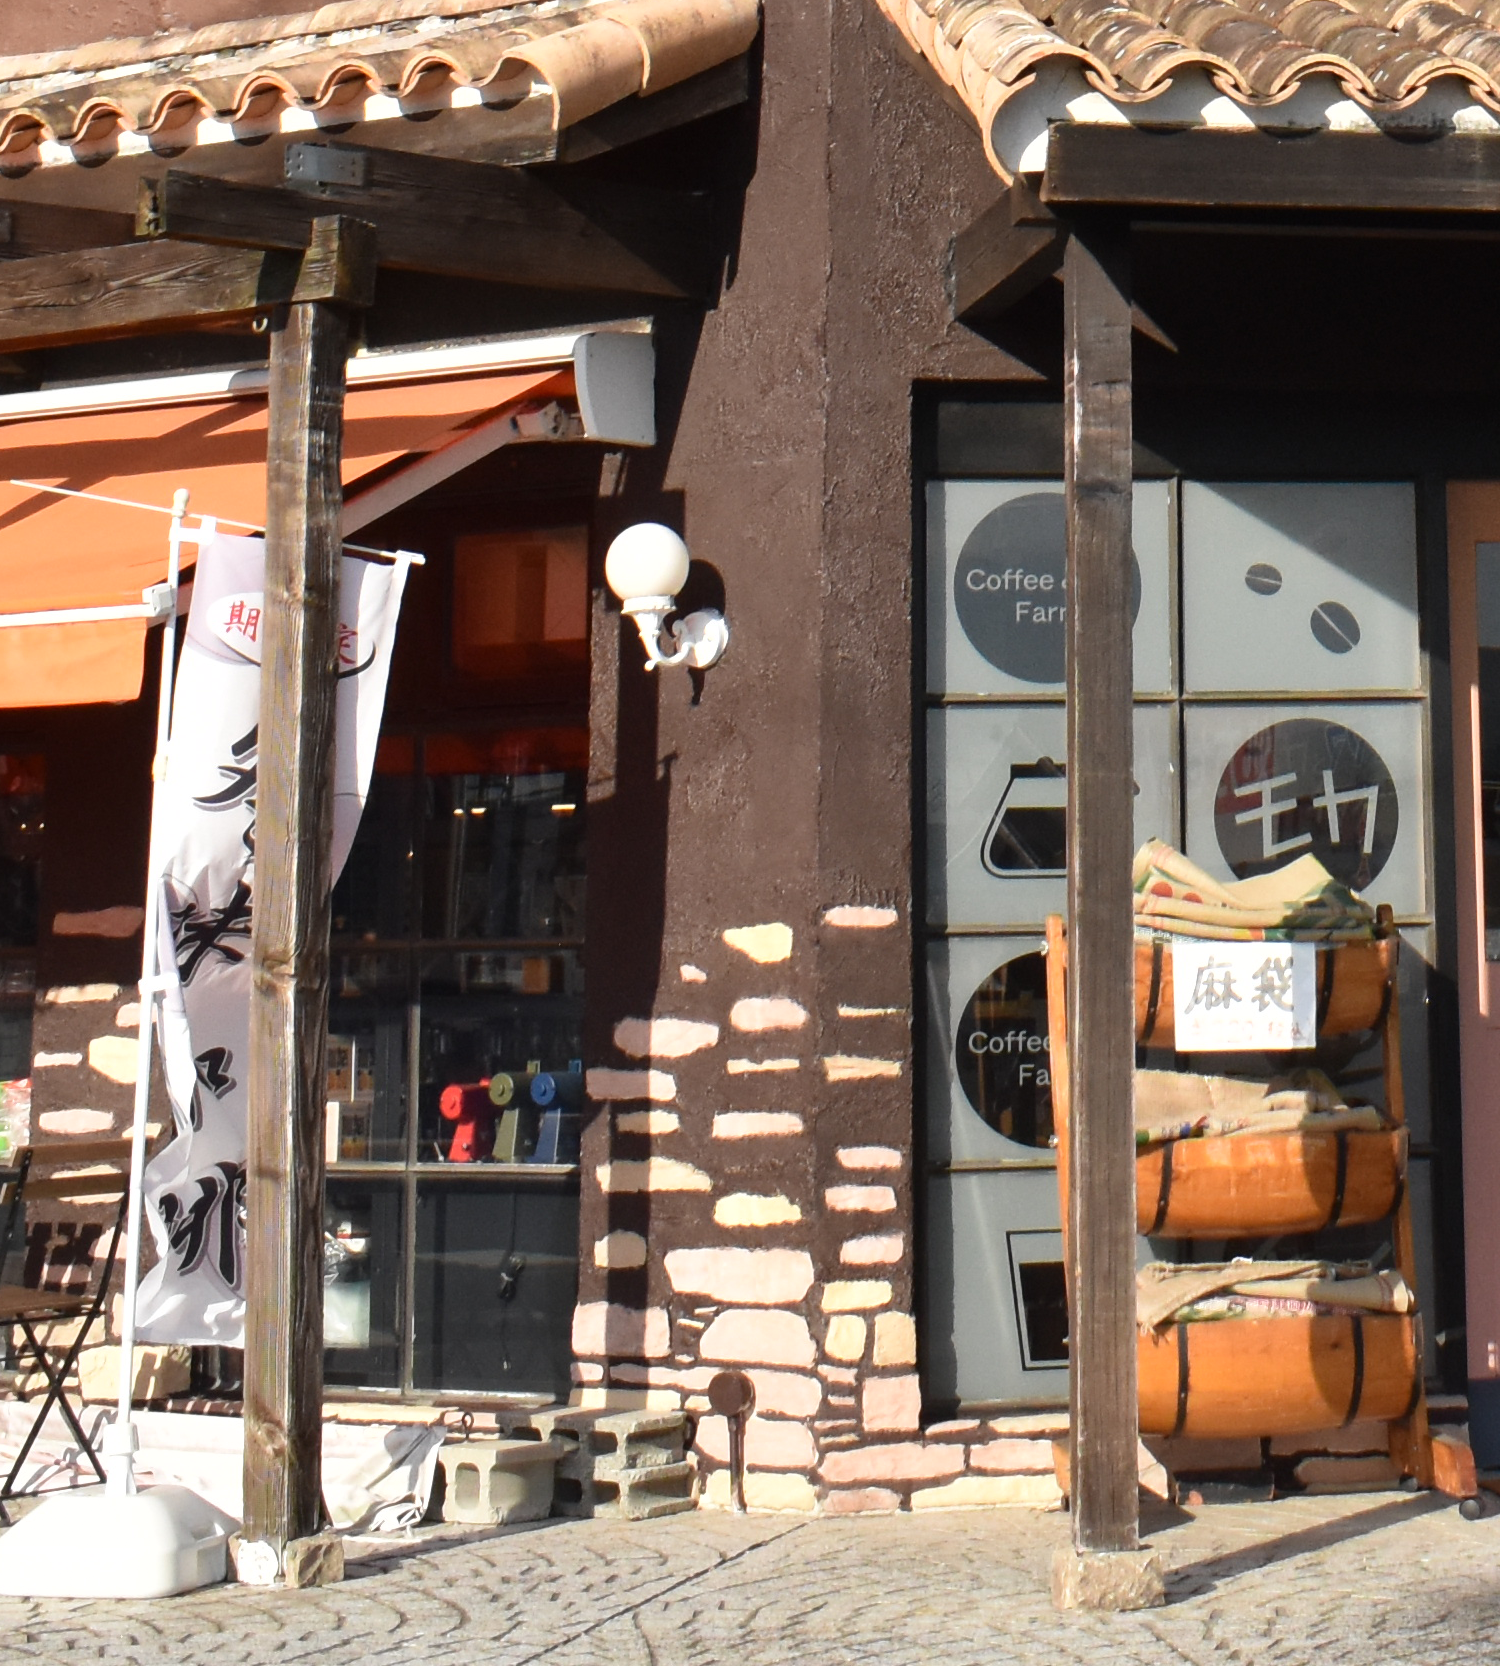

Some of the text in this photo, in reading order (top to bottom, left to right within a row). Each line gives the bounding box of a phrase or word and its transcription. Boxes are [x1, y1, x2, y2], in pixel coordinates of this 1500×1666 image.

[966, 568, 1055, 591] Coffee
[1016, 601, 1066, 623] Far
[1234, 769, 1379, 859] モカ
[1184, 956, 1295, 1014] 麻袋
